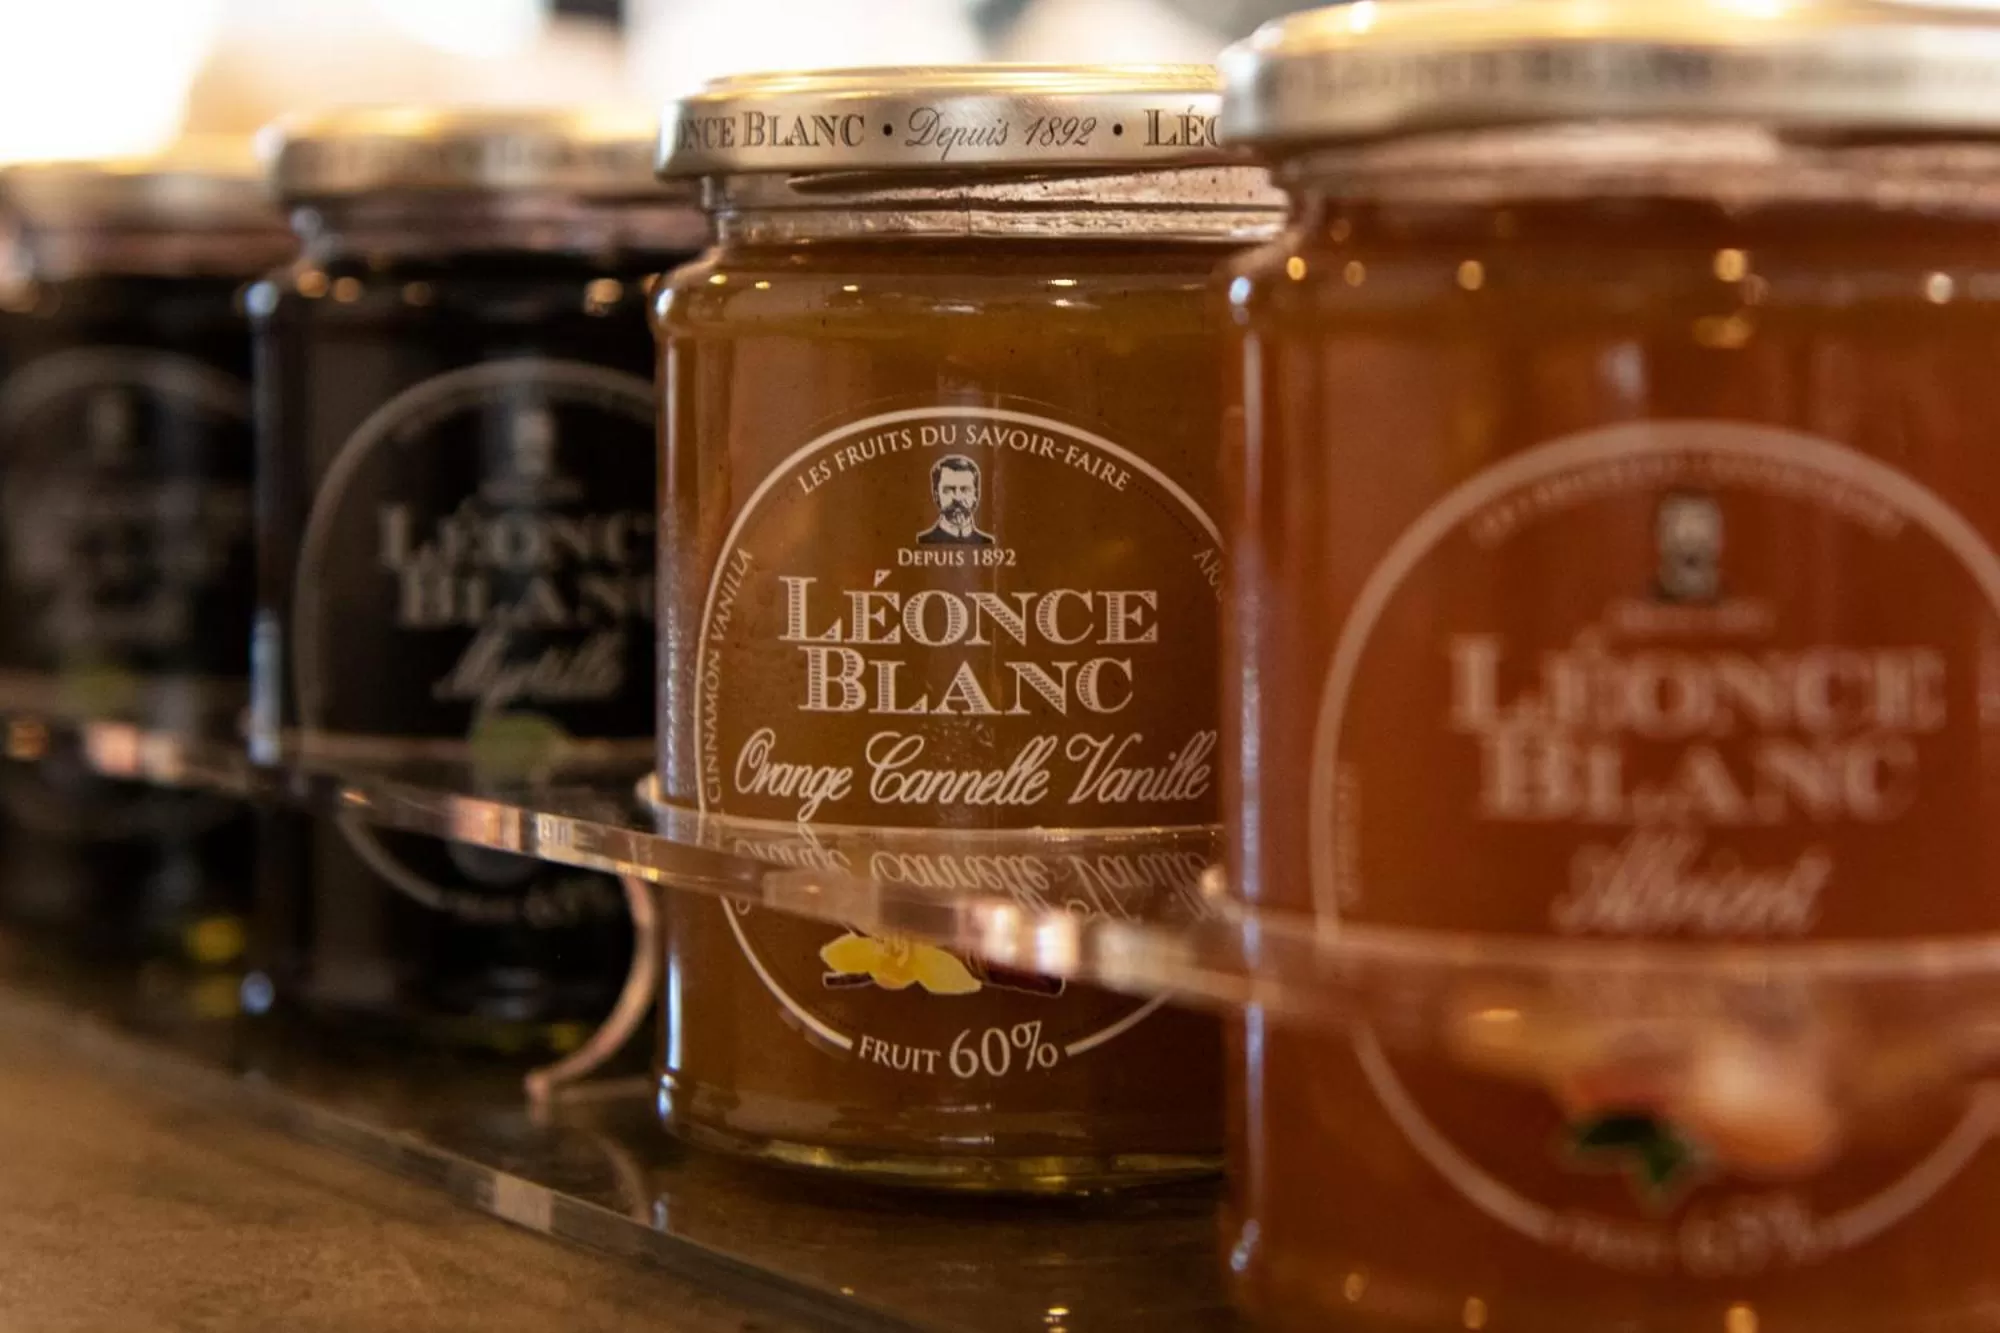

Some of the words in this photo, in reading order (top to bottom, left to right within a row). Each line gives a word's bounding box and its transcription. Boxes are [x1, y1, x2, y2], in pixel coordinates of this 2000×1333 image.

[741, 110, 865, 148] BLANC
[905, 107, 1010, 160] Depuis
[1025, 107, 1097, 148] 1892
[796, 459, 832, 496] LES
[834, 428, 913, 473] FRUITS
[920, 424, 957, 447] DU
[966, 424, 1131, 492] SAVOIR-FAIRE
[897, 547, 965, 567] DEPUIS
[971, 547, 1016, 568] 1892
[710, 547, 753, 641] VANILLA
[778, 569, 1159, 647] LÉONCE
[798, 645, 1134, 717] BLANC
[703, 648, 722, 804] CINNAMON
[734, 727, 853, 824] Orange
[865, 731, 1058, 806] Cannelle
[1065, 730, 1217, 805] Vanille
[859, 1034, 941, 1075] FRUIT
[950, 1020, 1058, 1079] 60%
